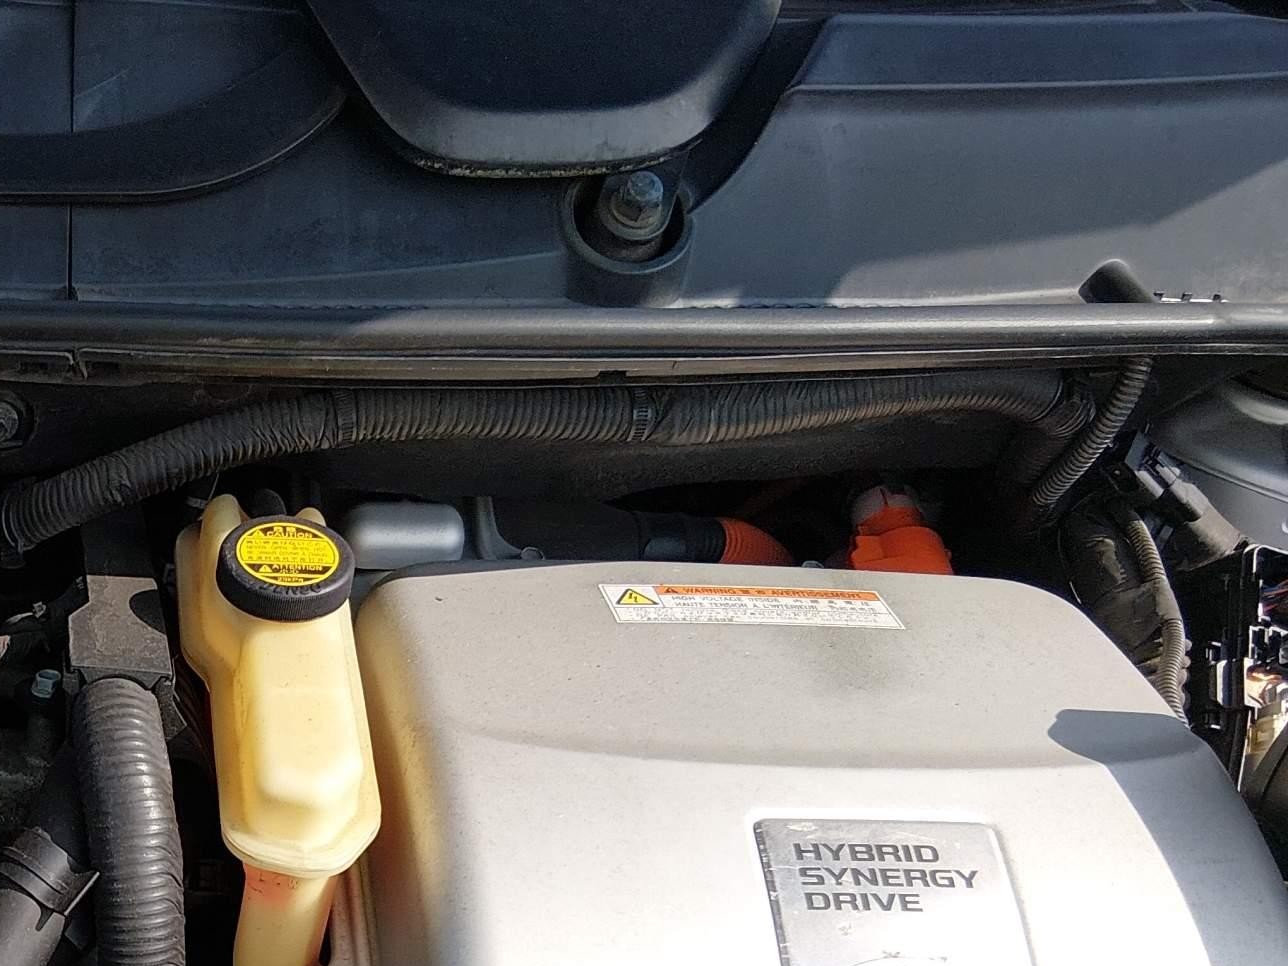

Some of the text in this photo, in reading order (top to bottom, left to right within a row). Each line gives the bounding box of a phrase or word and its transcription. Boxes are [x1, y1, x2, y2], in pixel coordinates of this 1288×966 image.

[266, 530, 313, 539] CAUTION
[683, 586, 737, 595] WARNING
[771, 589, 862, 599] AVERTISSEMENT
[792, 842, 940, 864] HYBRID
[799, 867, 978, 889] SYNERGY
[805, 892, 923, 913] DRIVE
